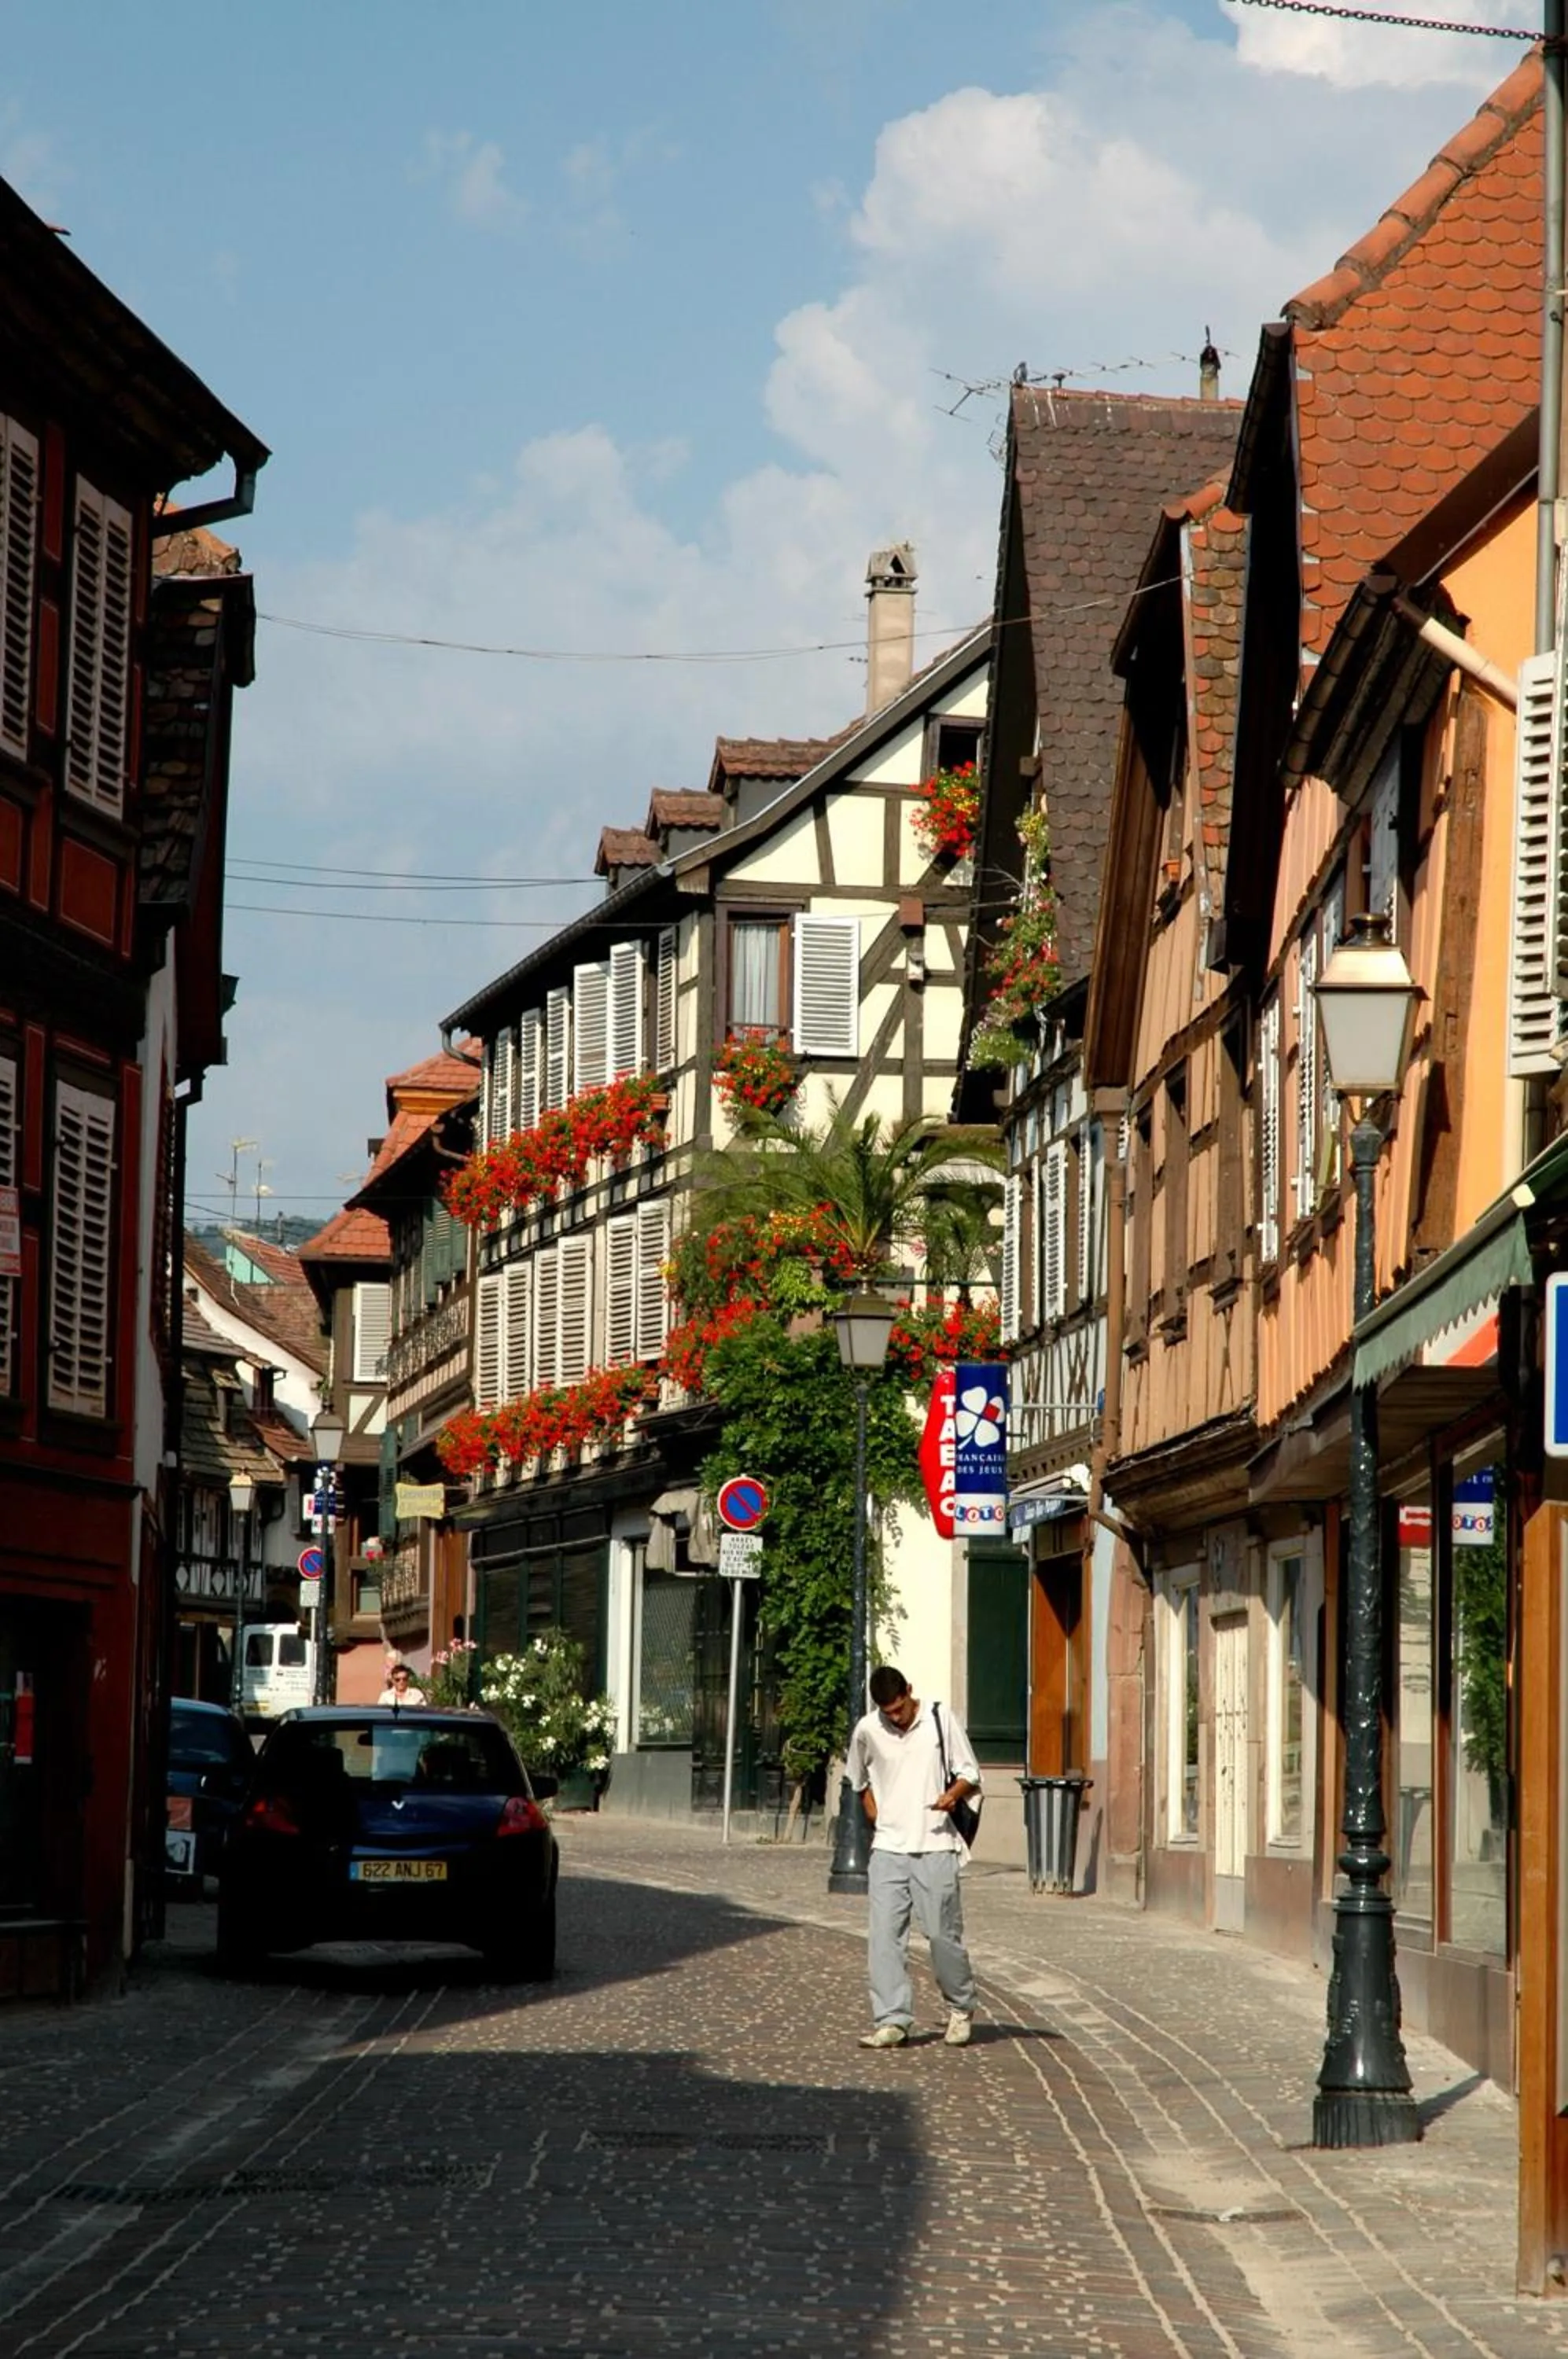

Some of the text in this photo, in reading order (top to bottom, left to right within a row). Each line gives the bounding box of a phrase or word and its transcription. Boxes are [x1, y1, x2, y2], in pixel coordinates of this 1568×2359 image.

[956, 1505, 1004, 1522] LOTO
[363, 1863, 391, 1877] 622
[425, 1863, 444, 1877] 67
